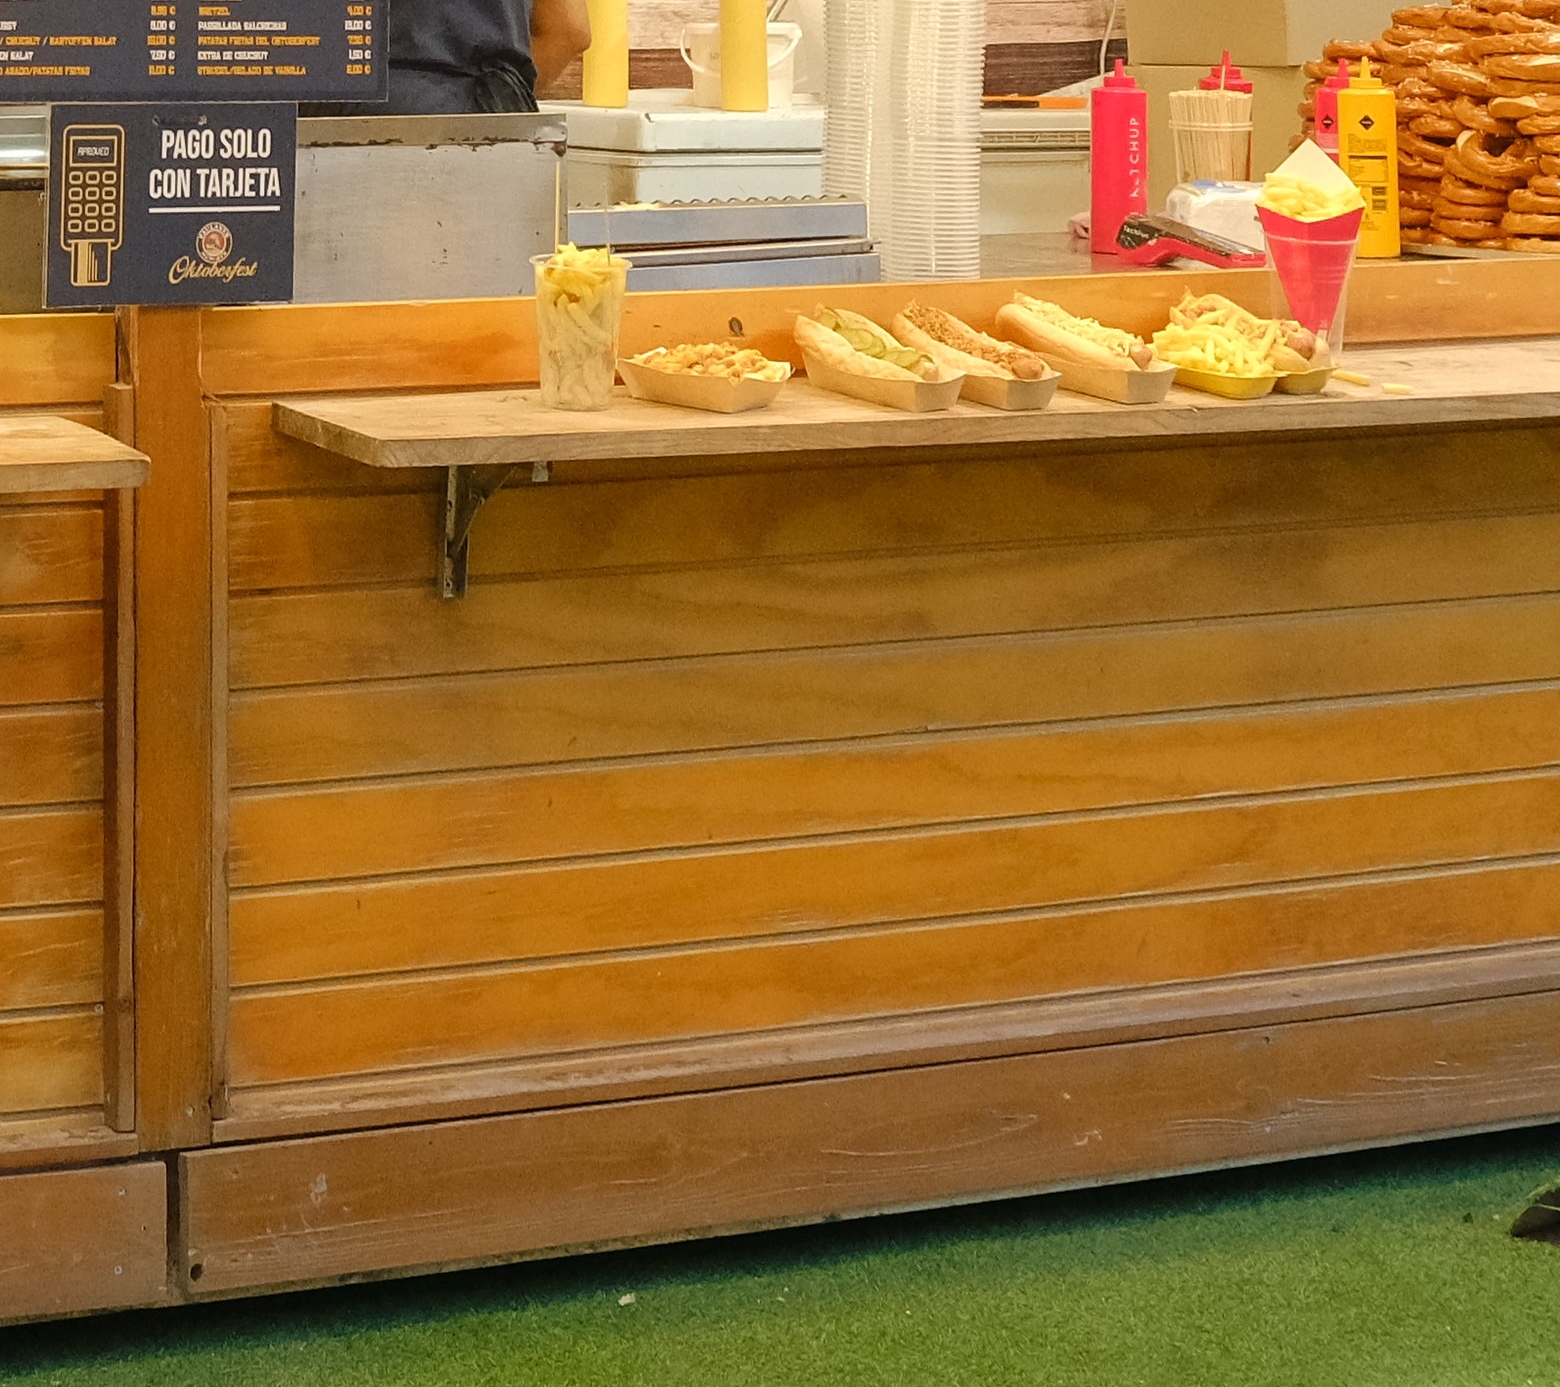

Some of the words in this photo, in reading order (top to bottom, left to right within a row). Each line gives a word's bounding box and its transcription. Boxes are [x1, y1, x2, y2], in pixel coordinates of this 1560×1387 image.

[160, 129, 214, 159] PAGO
[219, 128, 272, 159] SOLO
[148, 168, 191, 199] CON
[195, 167, 281, 199] TARJETA
[168, 255, 258, 285] Oktoberfest
